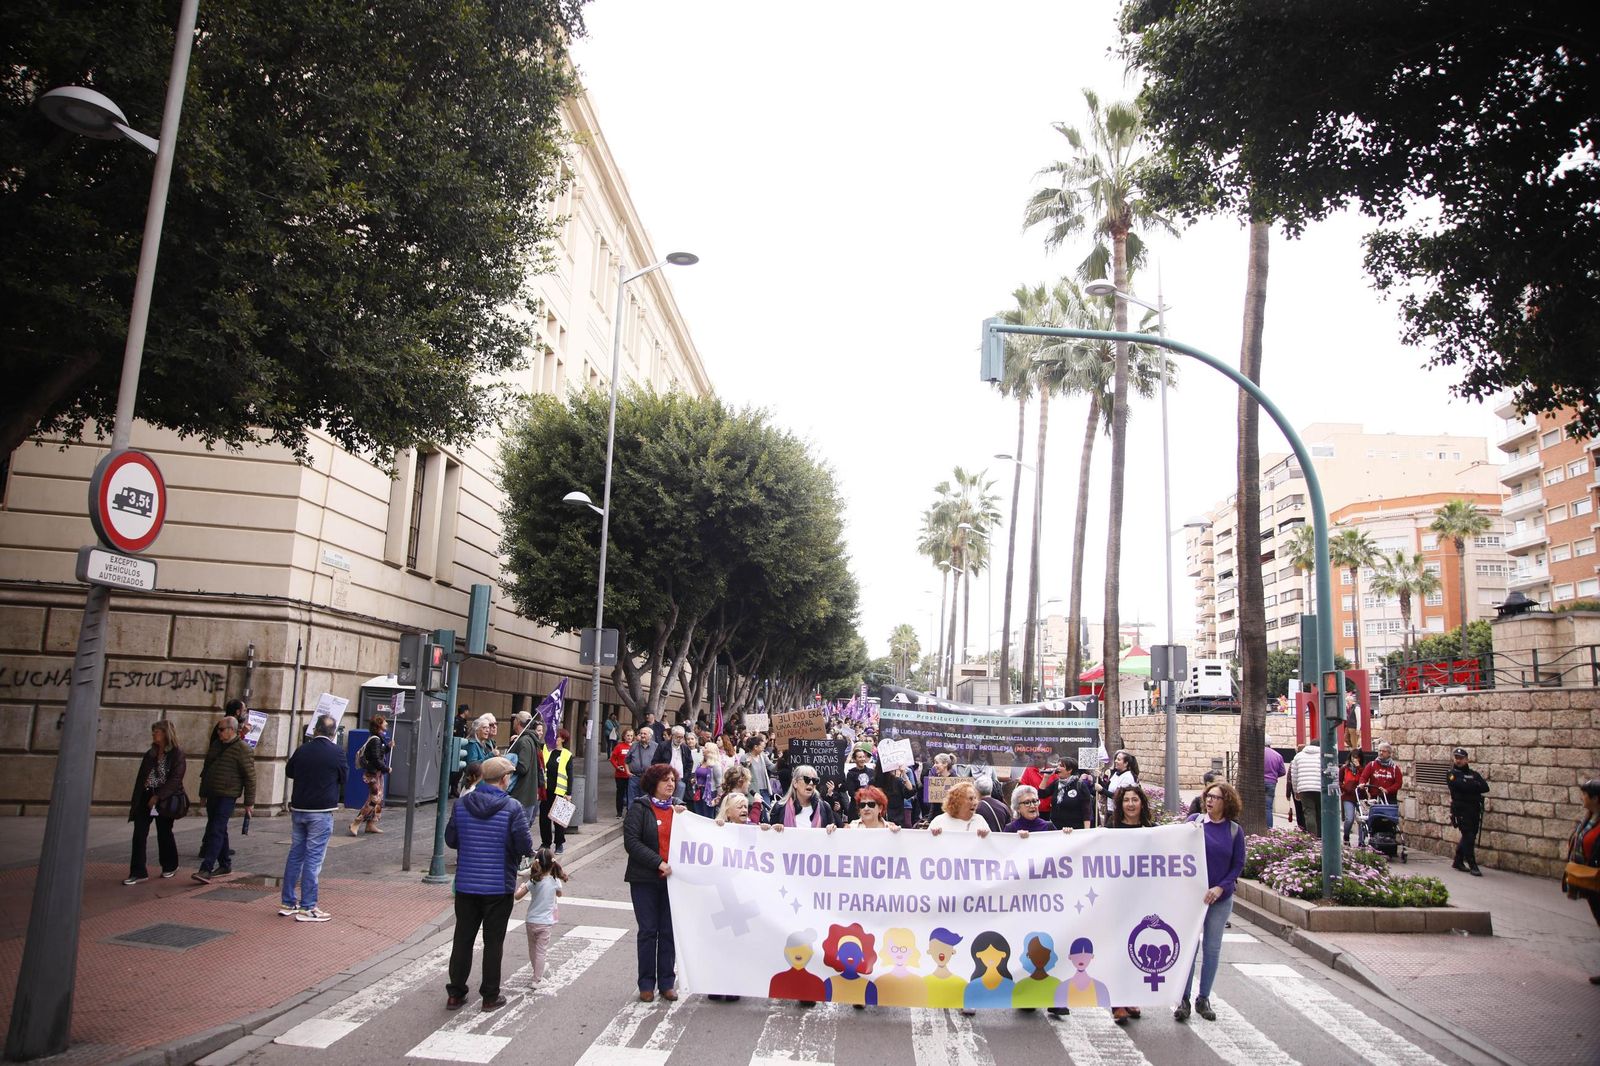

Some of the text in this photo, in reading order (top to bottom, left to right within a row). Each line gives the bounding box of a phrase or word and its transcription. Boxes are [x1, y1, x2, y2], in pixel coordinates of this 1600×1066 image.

[128, 491, 150, 508] 3,5t
[110, 556, 138, 568] EXCEPTO
[98, 572, 144, 586] AUTORIZADOS
[808, 710, 822, 718] ERA
[916, 714, 964, 722] Prostitución
[790, 755, 838, 764] NO TE ATREVAS
[680, 840, 1197, 880] NO MÁS VIOLENCIA CONTRA LAS MUJERES
[814, 892, 1064, 913] NI PARAMOS NI CALLAMOS
